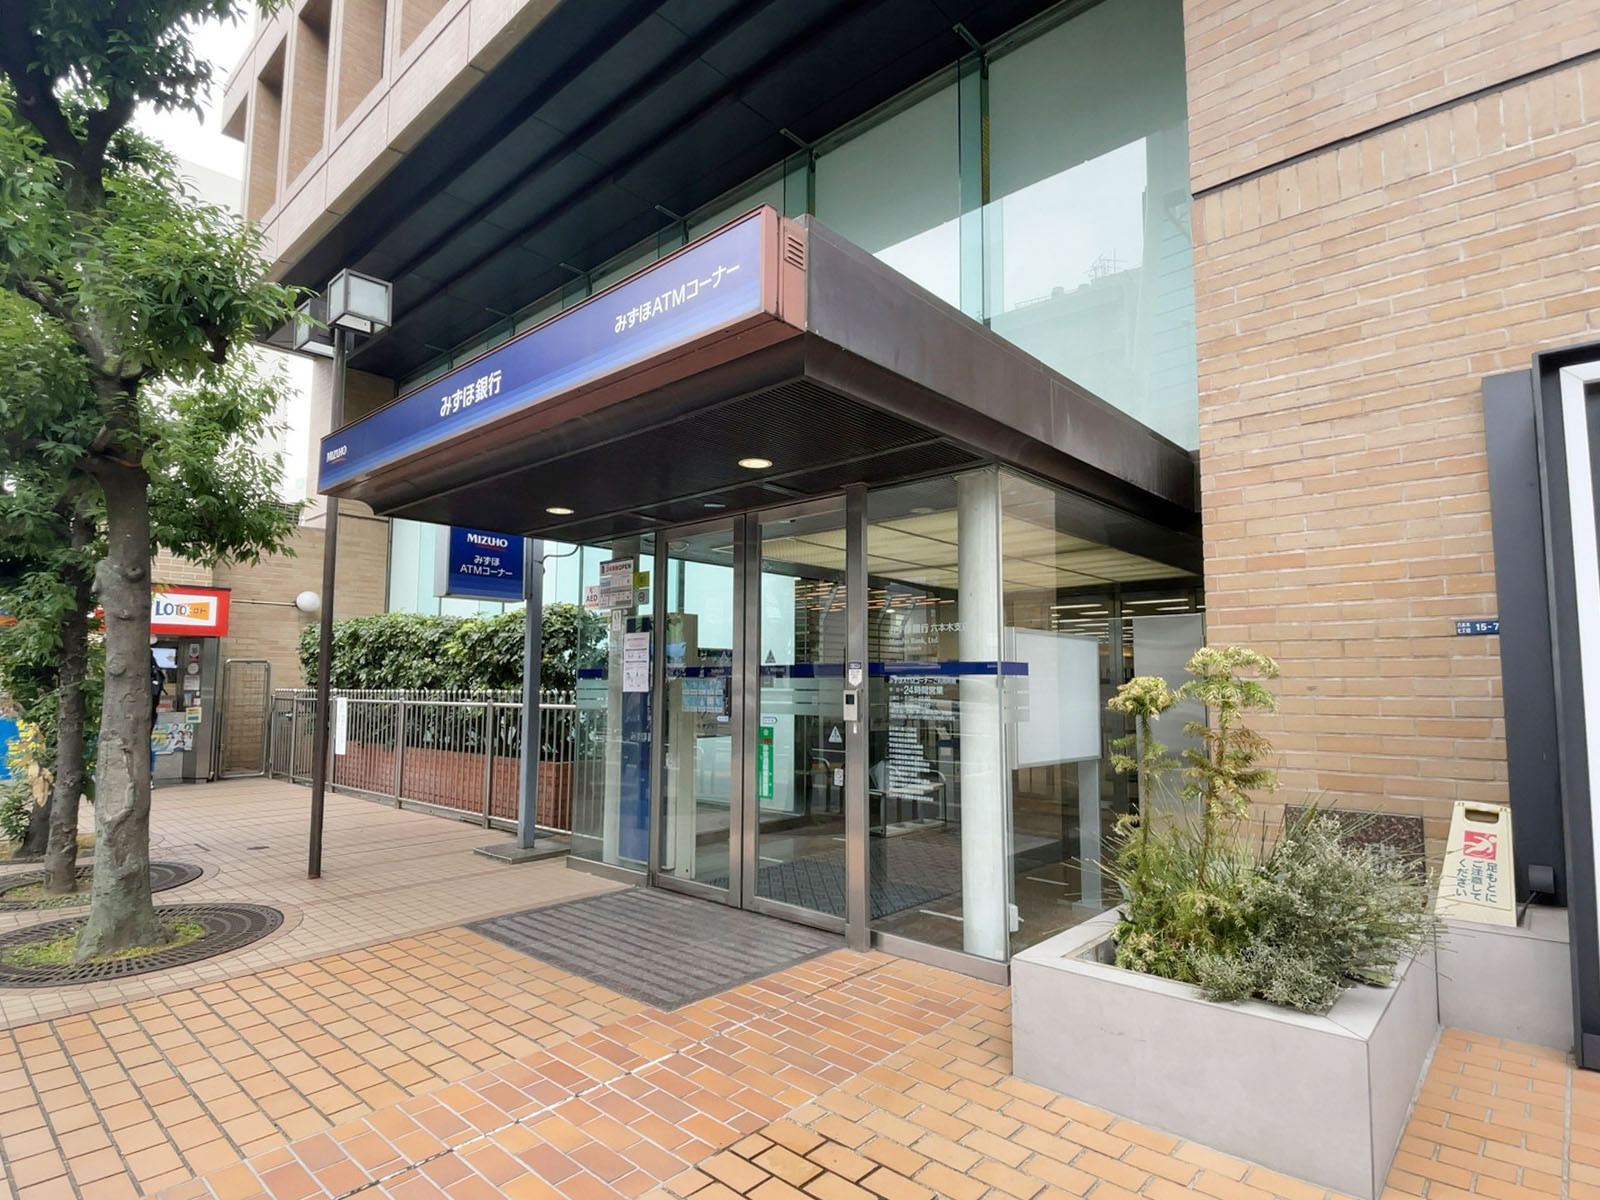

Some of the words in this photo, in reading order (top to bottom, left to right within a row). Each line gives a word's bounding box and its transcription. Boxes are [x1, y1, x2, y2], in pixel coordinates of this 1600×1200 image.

[614, 264, 740, 334] みずほATMコーナー
[439, 369, 502, 418] みずほ銀行
[325, 445, 348, 463] MIZUHO
[466, 533, 509, 549] MIZUHO
[473, 554, 501, 567] みずほ
[459, 564, 513, 577] ATMコーナー
[155, 600, 188, 616] LOTO
[1475, 622, 1500, 631] 15-7
[1455, 857, 1470, 898] ください
[1485, 861, 1498, 904] 足もとに
